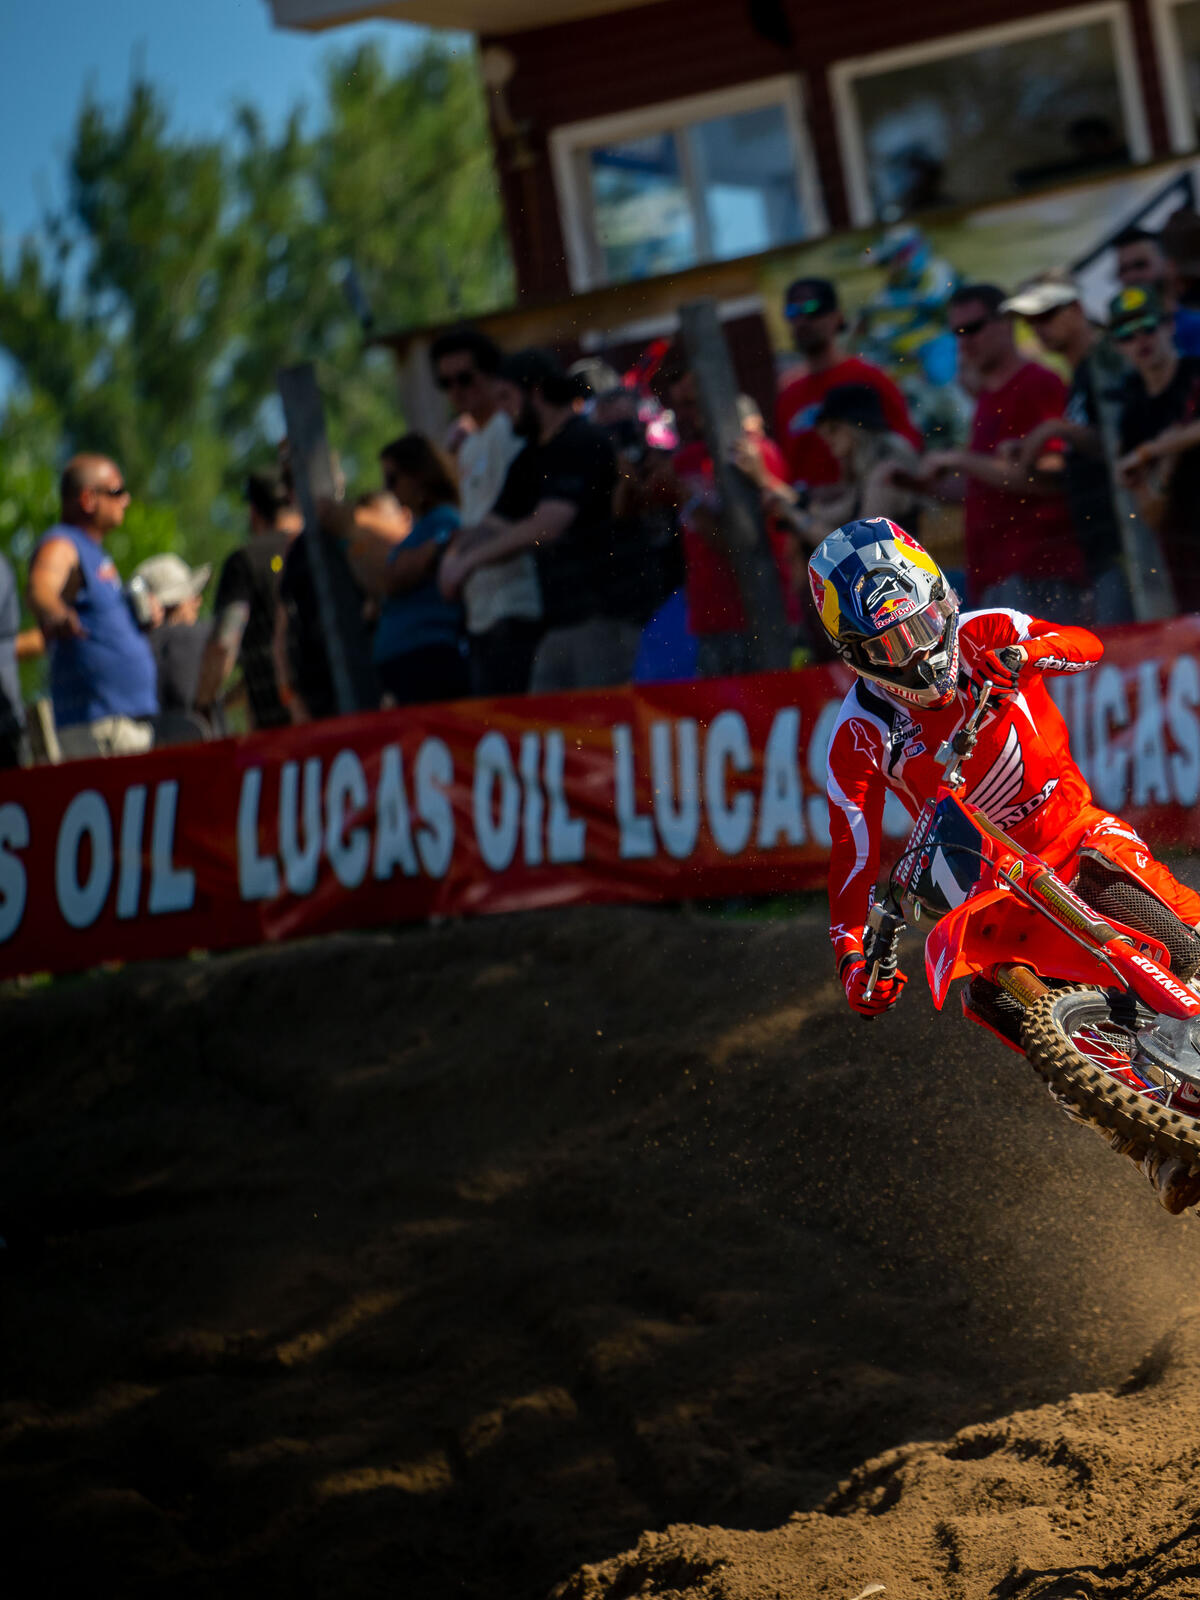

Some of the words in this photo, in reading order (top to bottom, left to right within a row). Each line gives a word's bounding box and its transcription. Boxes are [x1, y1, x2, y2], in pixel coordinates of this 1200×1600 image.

[875, 613, 896, 629] Red
[895, 601, 916, 621] Bull
[892, 723, 922, 744] SHOWA
[55, 781, 196, 930] OIL
[238, 737, 455, 901] LUCAS
[473, 729, 586, 873] OIL
[931, 842, 968, 911] 1
[1131, 955, 1200, 1008] DUNLOP
